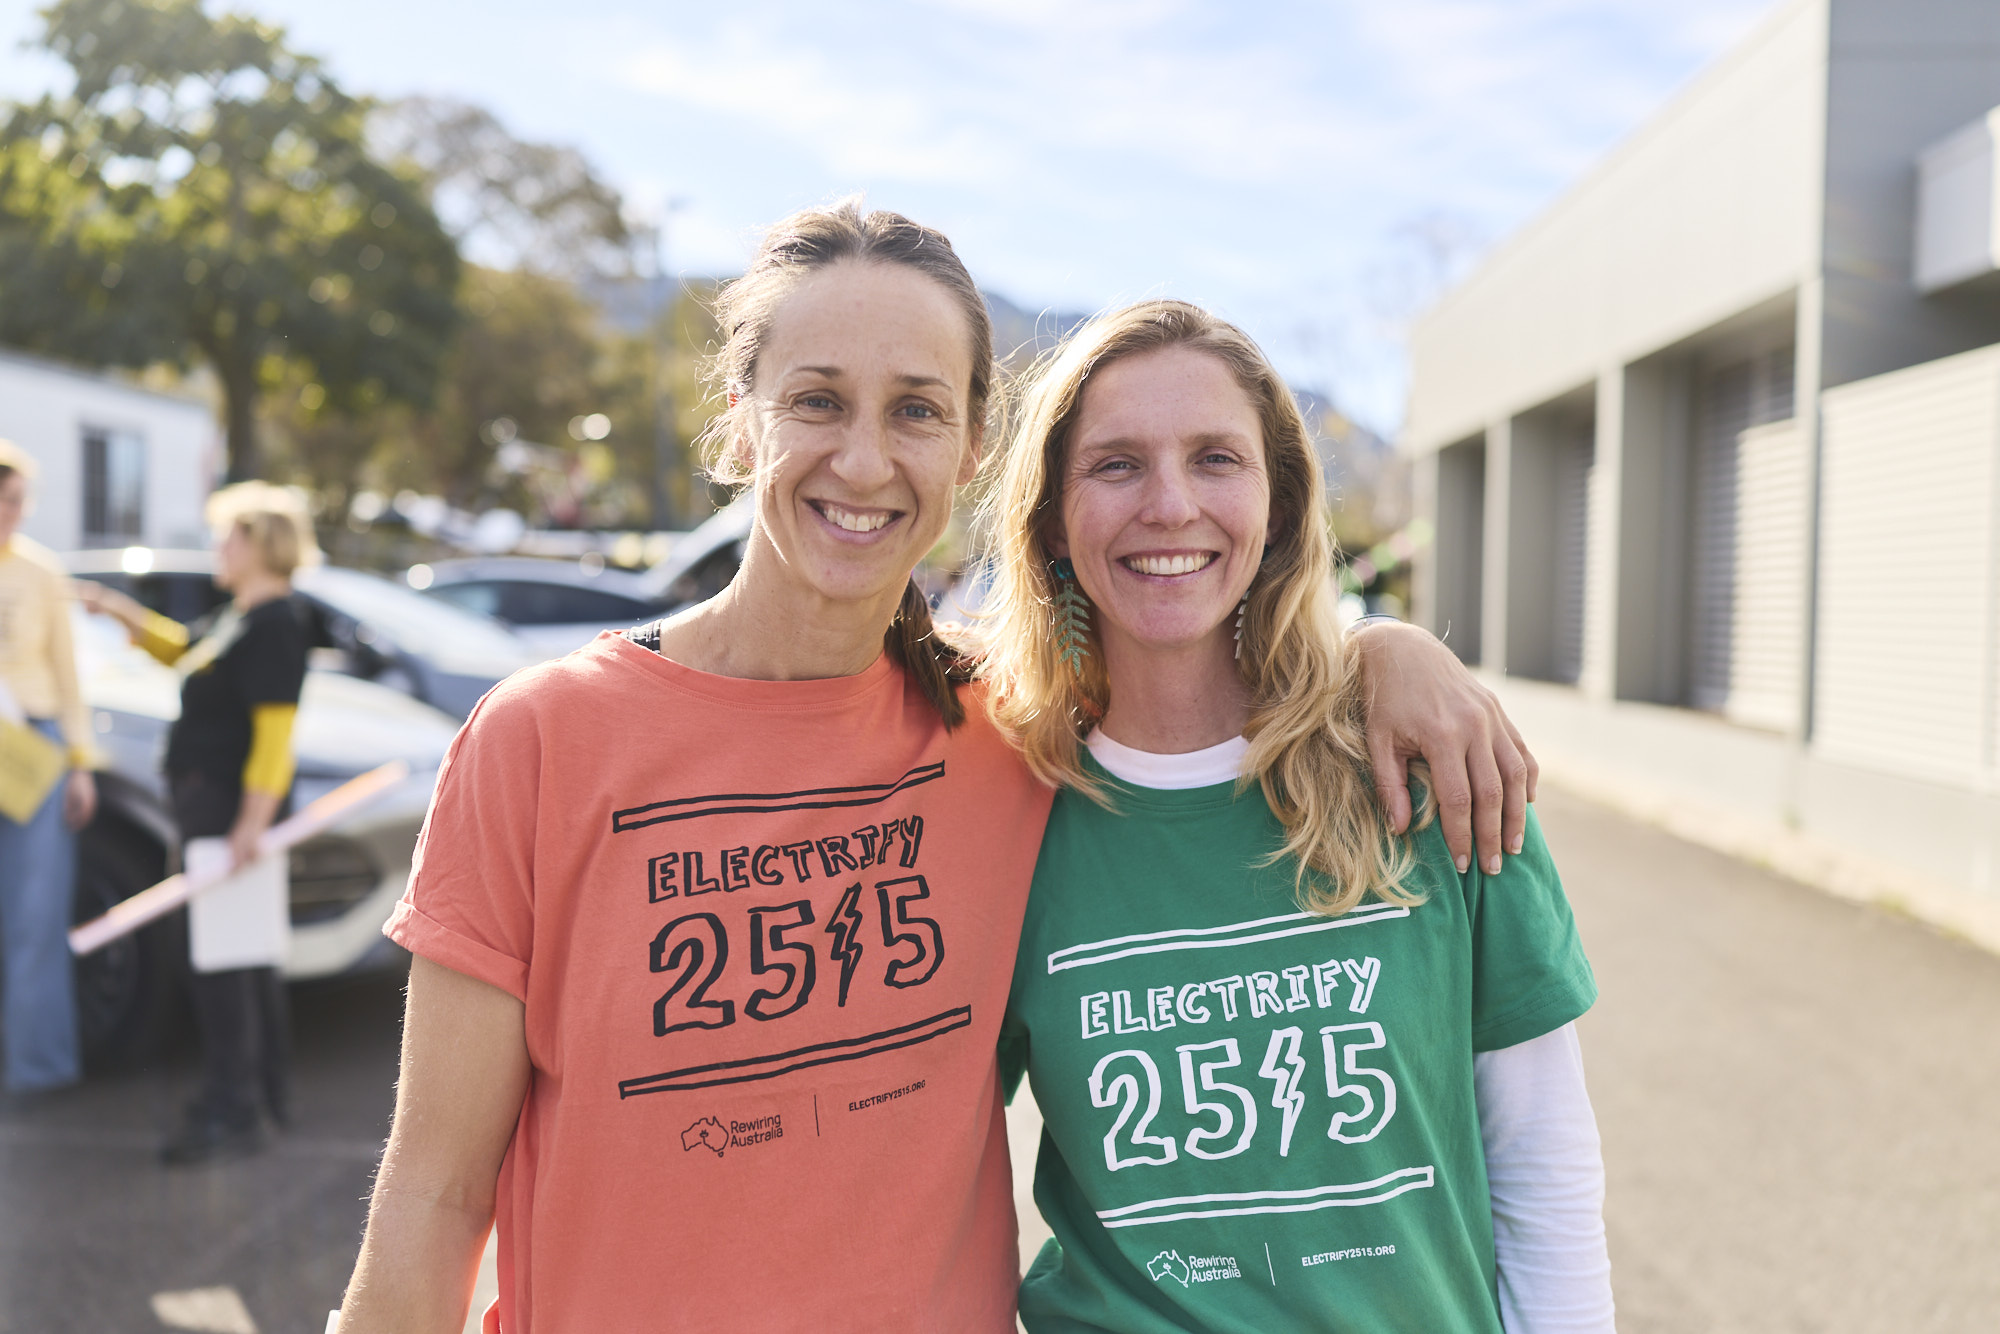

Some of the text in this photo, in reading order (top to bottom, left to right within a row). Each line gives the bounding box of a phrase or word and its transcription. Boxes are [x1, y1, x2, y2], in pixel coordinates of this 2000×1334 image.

[648, 815, 924, 903] ELECTRIFY
[1080, 956, 1381, 1039] ELECTRIFY
[849, 1079, 926, 1111] ELECTRIFY2515.ORG
[731, 1115, 782, 1133] Rewiring
[731, 1127, 784, 1147] Australia
[1189, 1255, 1237, 1270] Rewiring
[1302, 1245, 1395, 1267] ELECTRIFY2515.ORG
[1191, 1266, 1241, 1283] Australia
